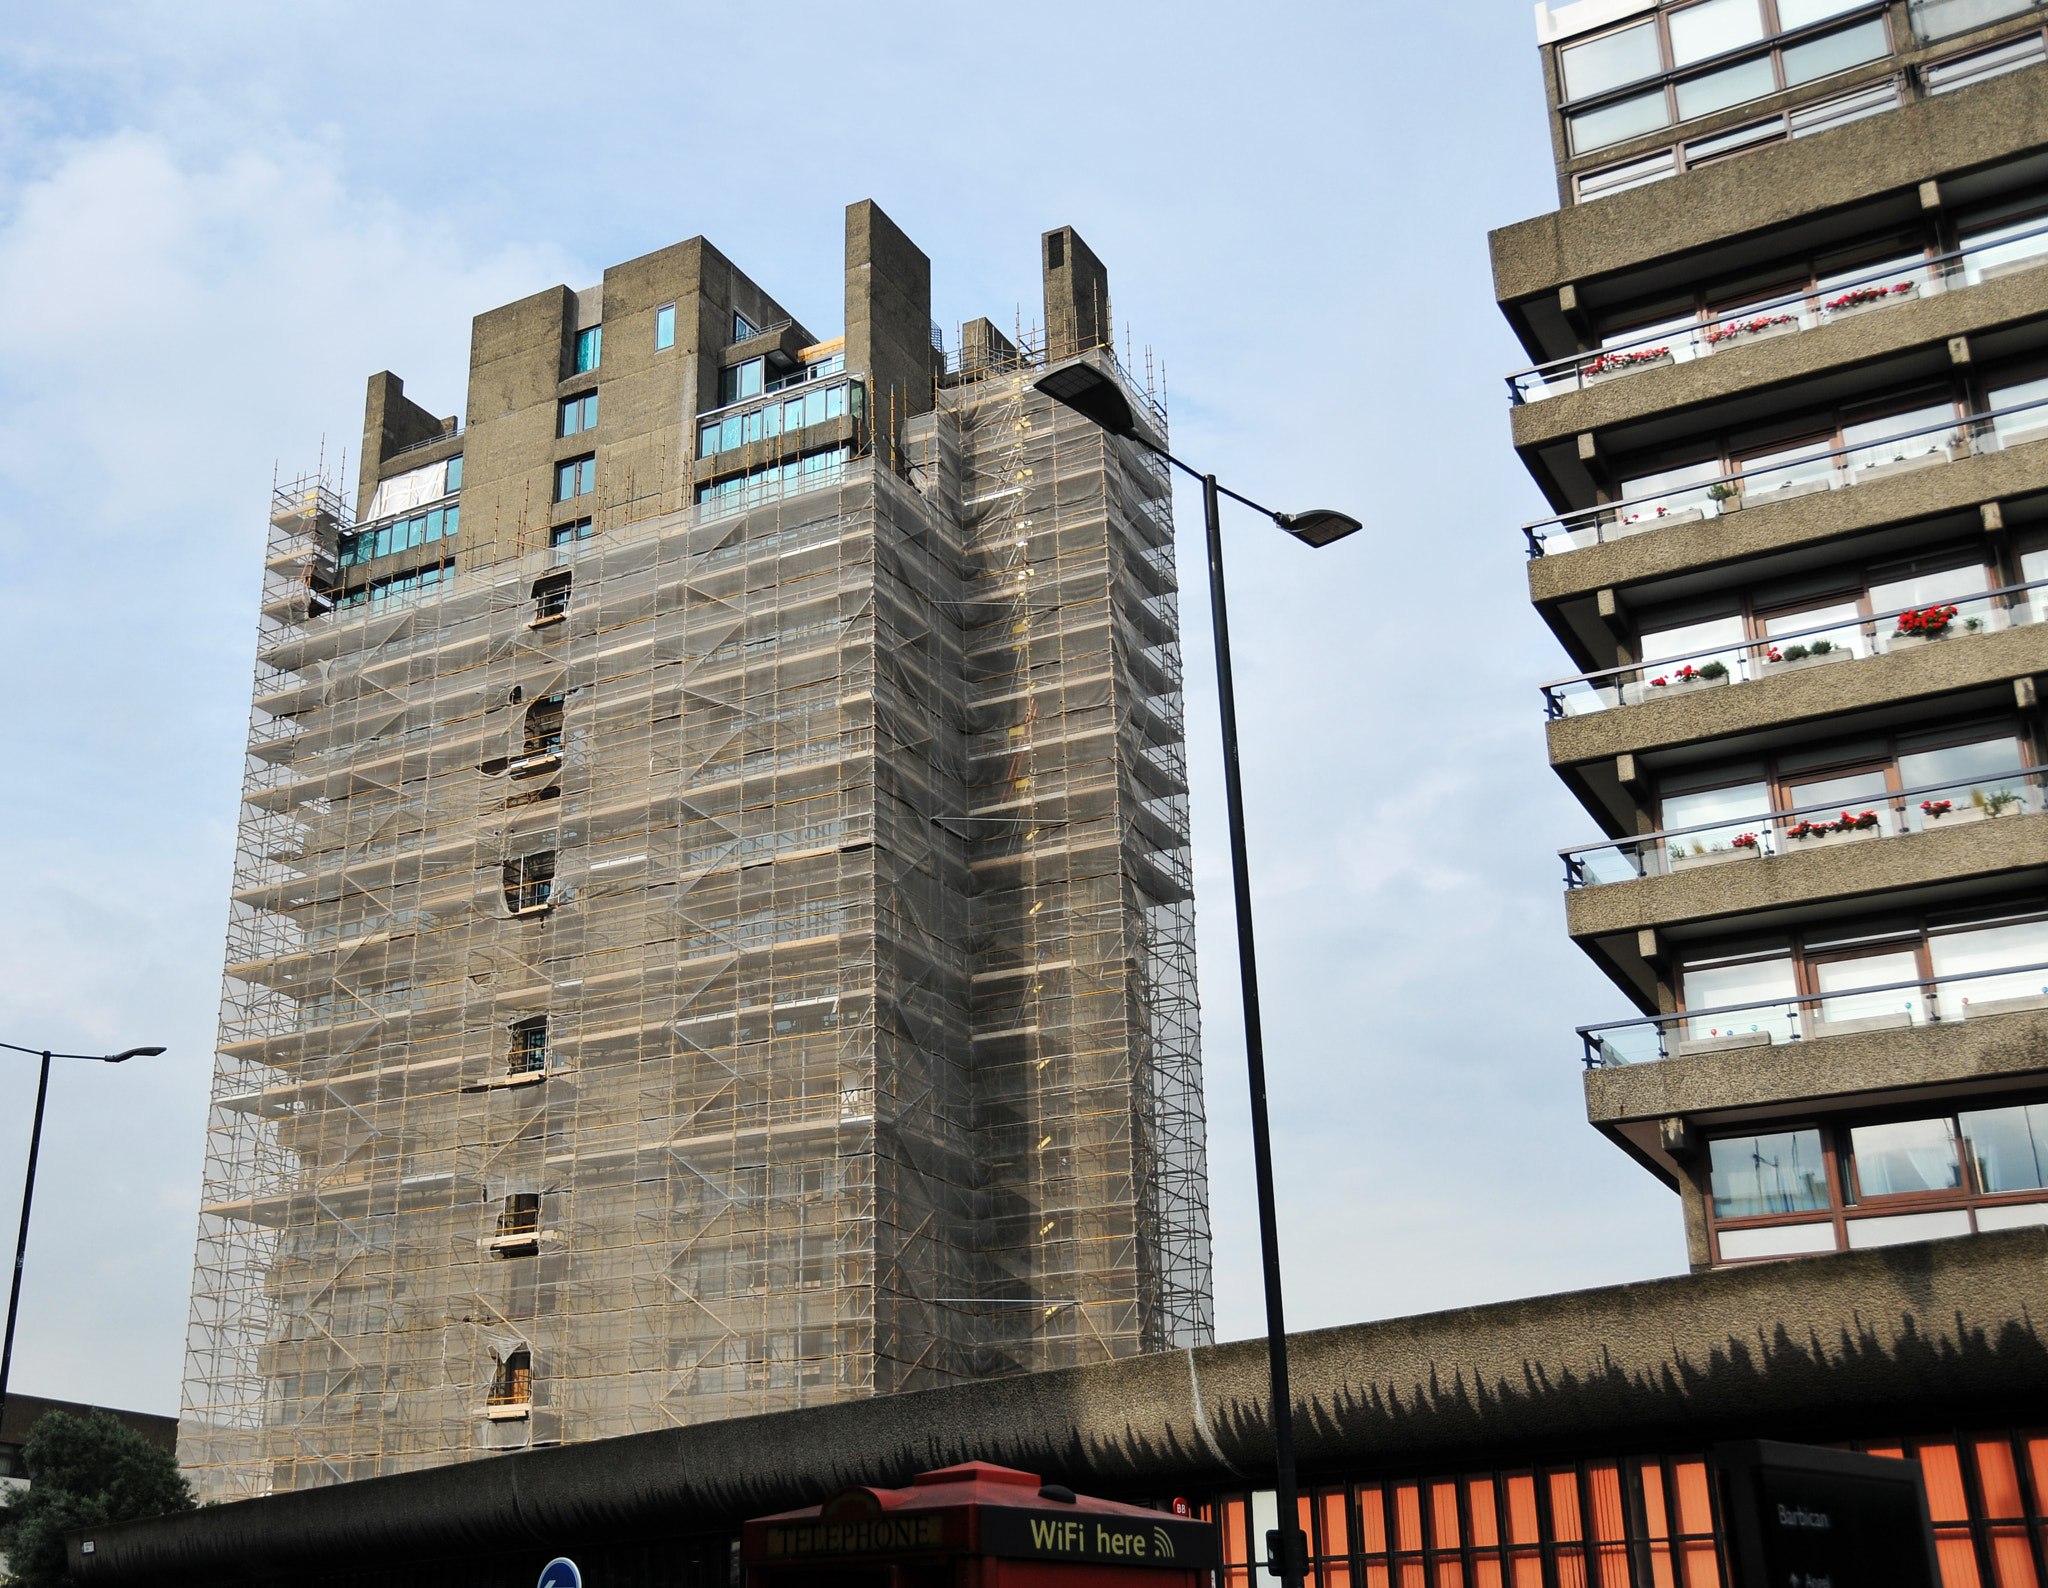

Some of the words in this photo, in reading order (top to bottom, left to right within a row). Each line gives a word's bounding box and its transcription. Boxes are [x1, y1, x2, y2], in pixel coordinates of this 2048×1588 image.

[1776, 1503, 1831, 1528] Barbican
[777, 1516, 930, 1555] TELEPHONE
[1030, 1519, 1084, 1552] WiFi
[1097, 1523, 1146, 1556] here
